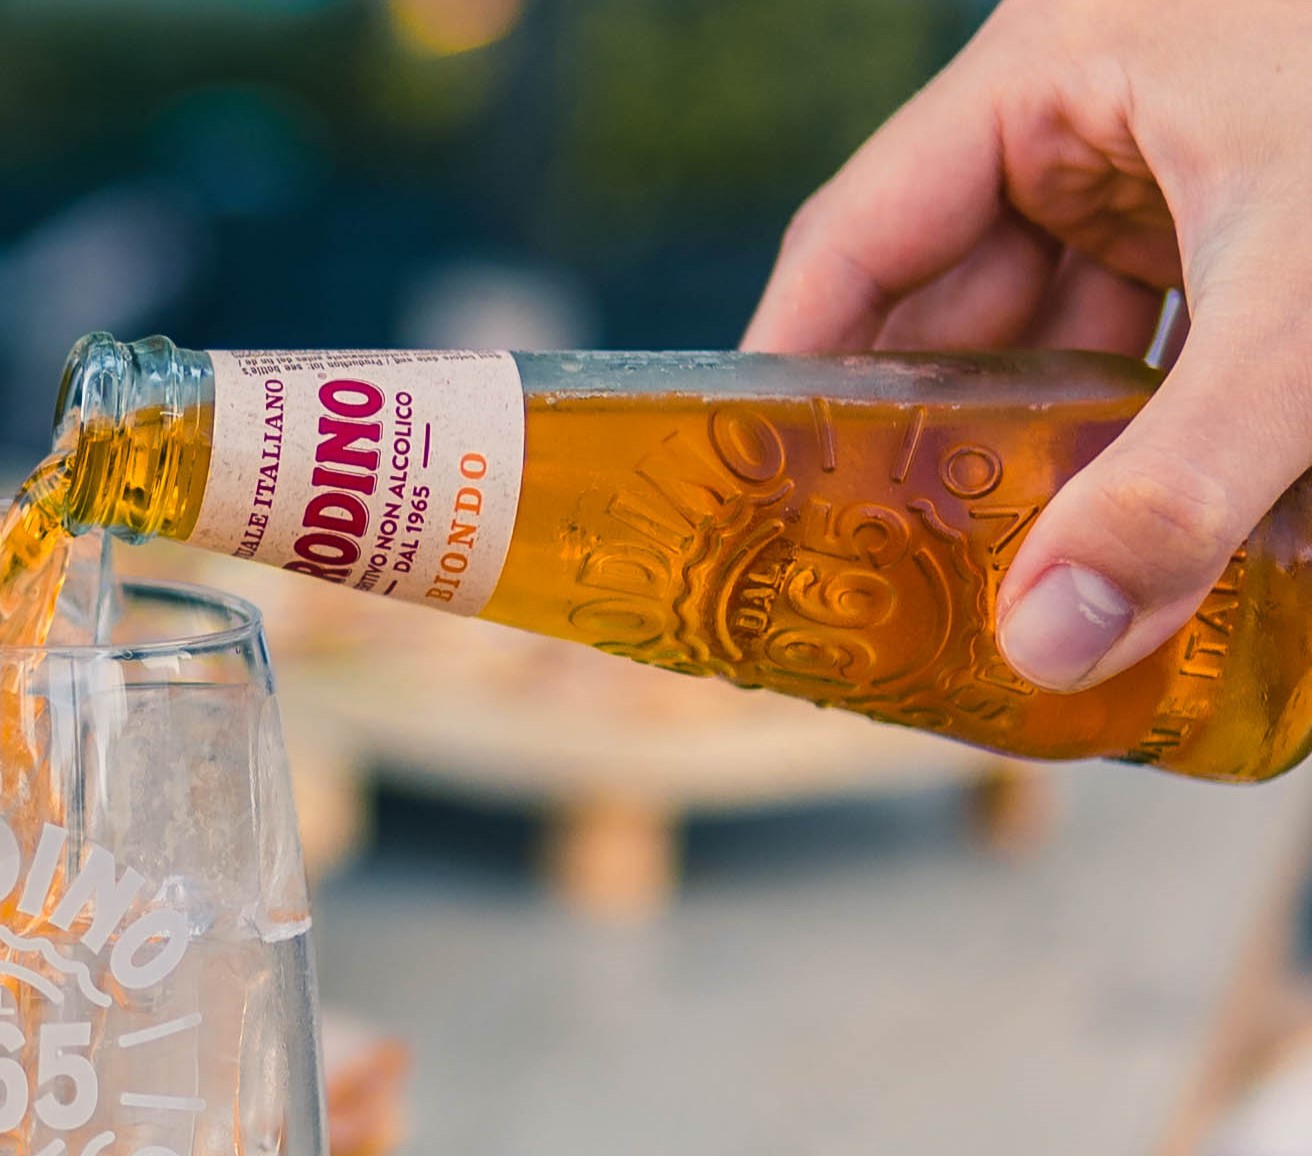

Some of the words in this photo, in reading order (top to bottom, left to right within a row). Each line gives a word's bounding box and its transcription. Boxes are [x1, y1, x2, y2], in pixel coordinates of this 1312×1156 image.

[284, 363, 303, 371] see
[254, 379, 285, 508] ITALIANO
[282, 378, 385, 584] RODINO
[376, 502, 402, 552] NON
[389, 391, 413, 500] ALCOLICO
[393, 539, 419, 573] DAL
[405, 485, 430, 533] 1965
[425, 453, 488, 602] BIONDO
[733, 559, 790, 635] DAL
